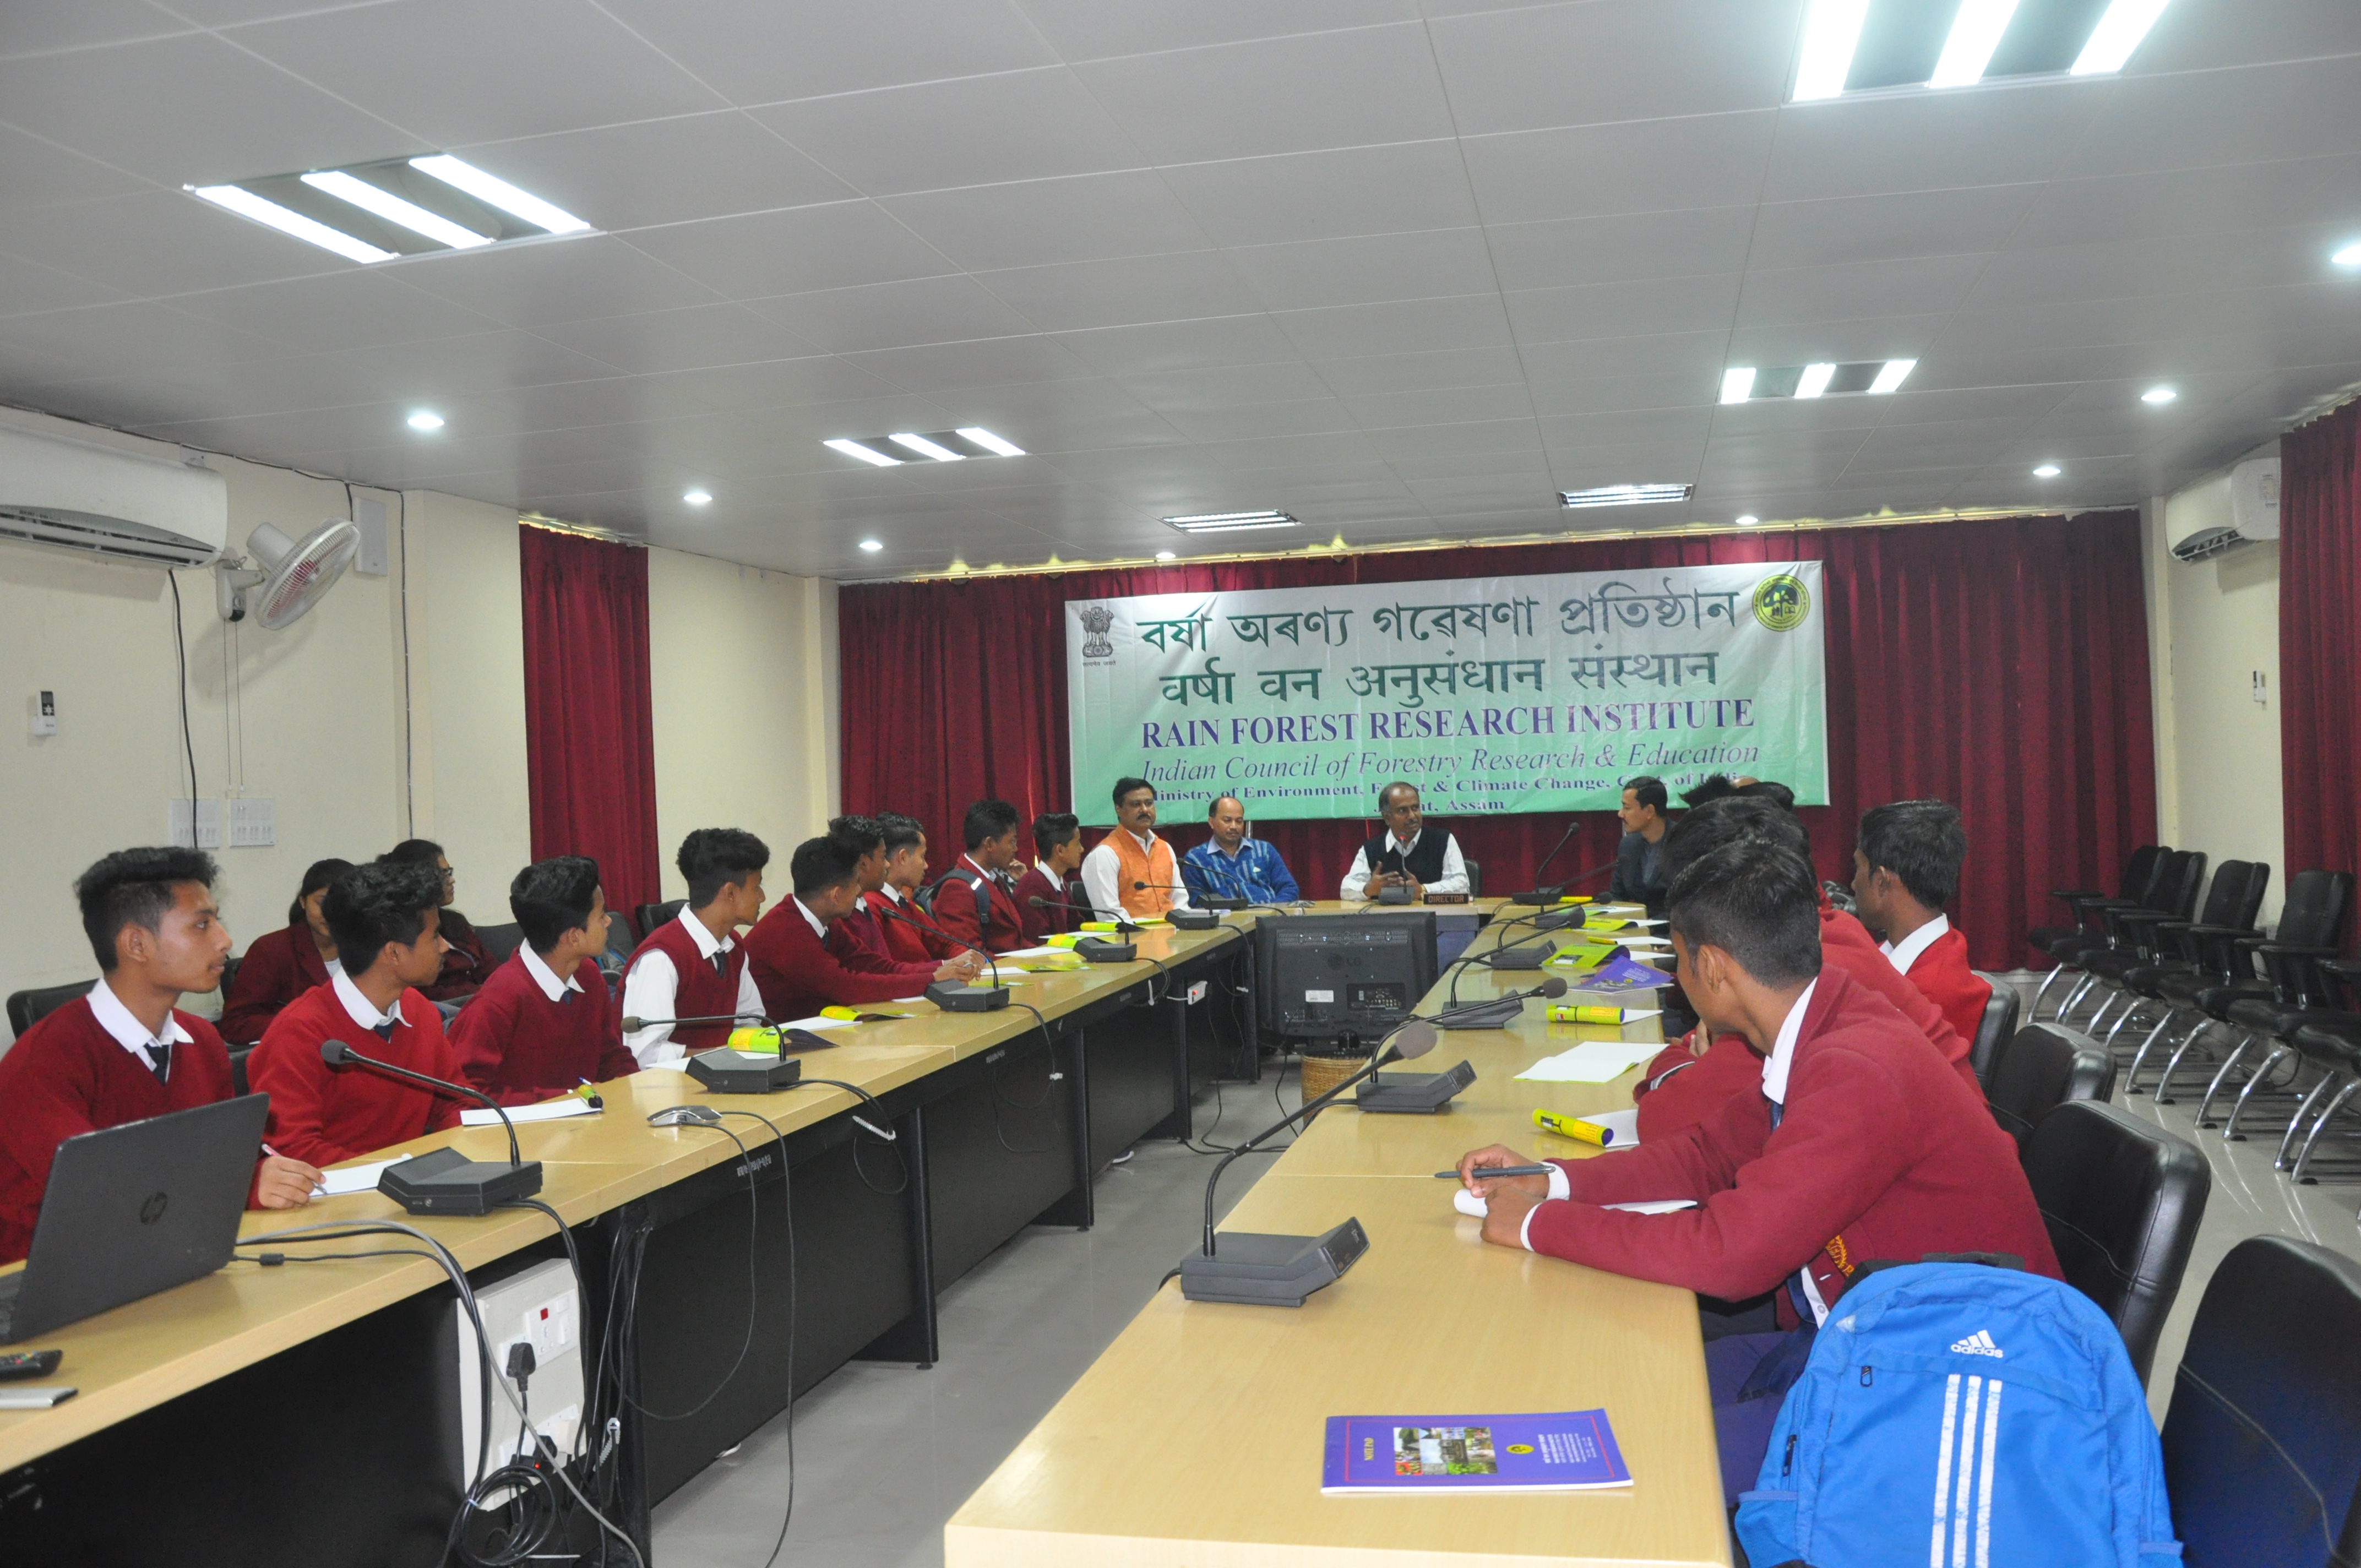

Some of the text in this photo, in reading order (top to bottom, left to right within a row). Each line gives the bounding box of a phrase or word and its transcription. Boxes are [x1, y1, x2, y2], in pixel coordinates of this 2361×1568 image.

[1159, 643, 1719, 708] वर्षा वन अनुसंधान संस्थान
[1141, 699, 1754, 748] RAIN FOREST RESEARCH INSTITUTE
[1143, 742, 1759, 781] Indian Council of Forestry Research & Education
[1221, 787, 1238, 798] of
[1244, 784, 1364, 798] Environment,
[1433, 781, 1449, 792] &
[1456, 777, 1527, 792] Climate
[1535, 777, 1610, 791] Change,
[1675, 773, 1694, 785] of
[1445, 799, 1504, 812] Assam
[1428, 895, 1465, 903] DIRECTOR
[1950, 1344, 2004, 1358] adidas
